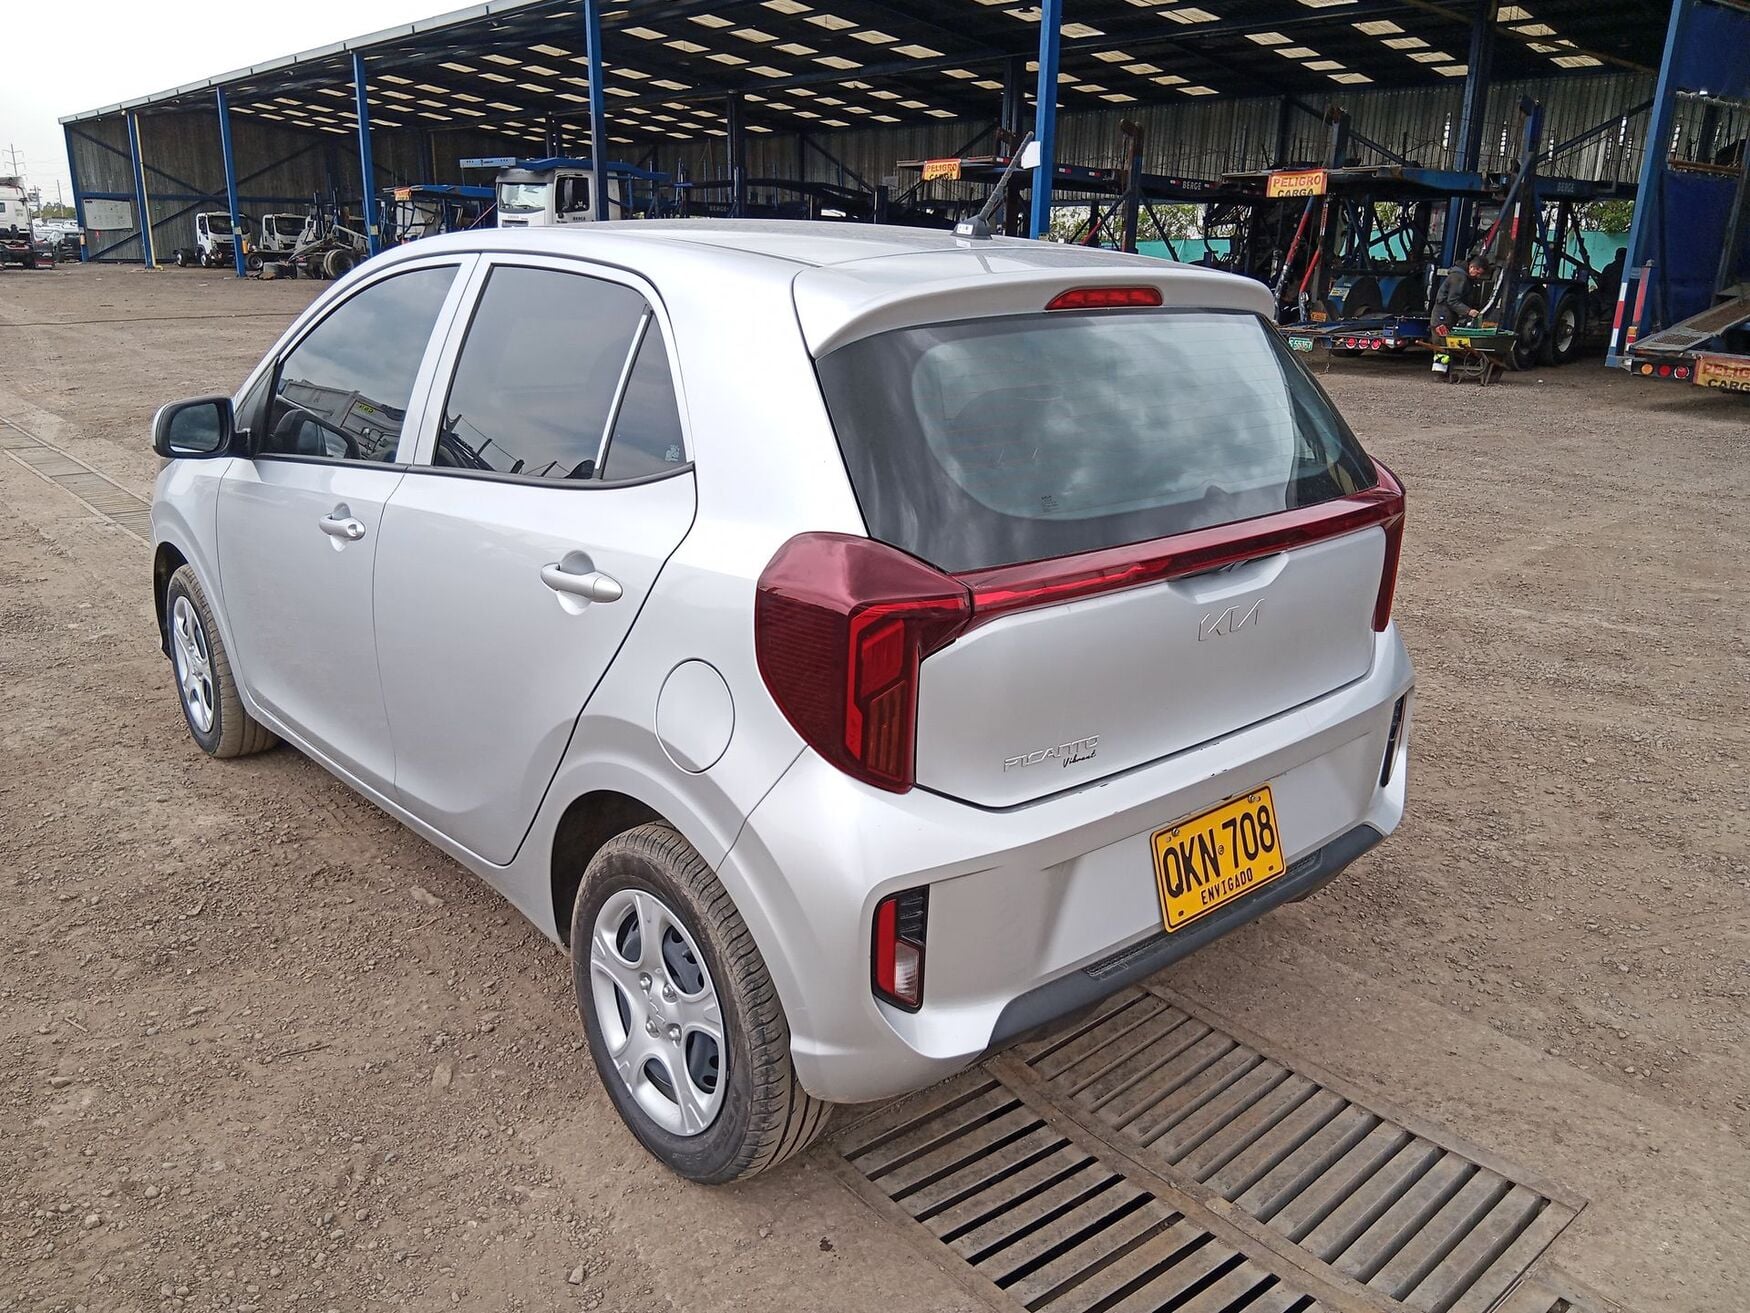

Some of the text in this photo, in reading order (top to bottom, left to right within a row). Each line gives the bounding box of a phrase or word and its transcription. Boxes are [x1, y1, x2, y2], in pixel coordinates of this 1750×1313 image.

[927, 163, 957, 173] PELIGRO
[1273, 175, 1321, 188] PELIGRO
[1277, 188, 1314, 197] CARGA
[1198, 598, 1265, 641] KIA
[1003, 735, 1100, 772] PICANTO
[1062, 749, 1097, 769] Vibrant
[1163, 805, 1275, 898] QKN 708
[1201, 867, 1253, 905] ENVIGADO
